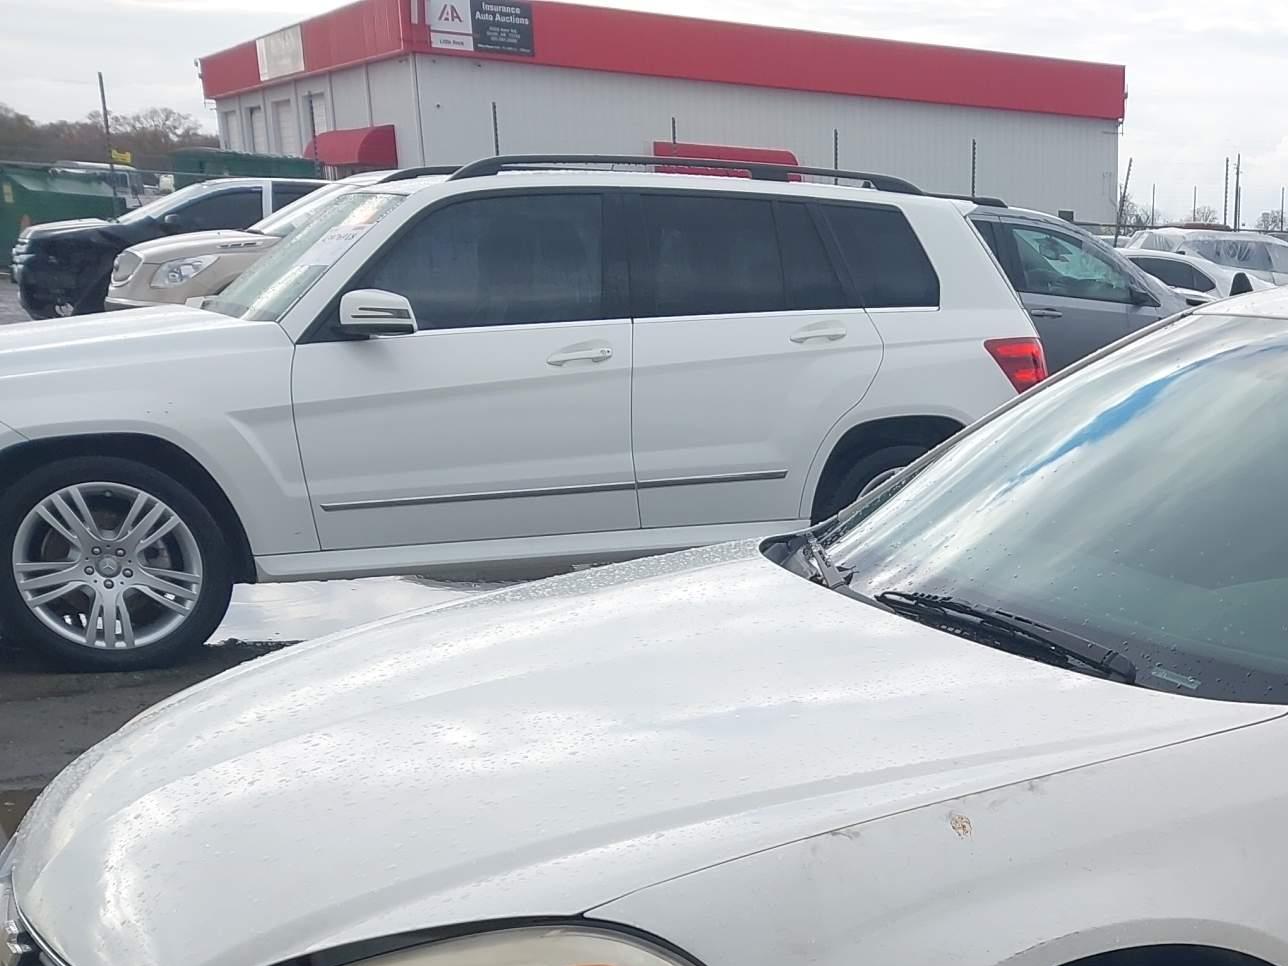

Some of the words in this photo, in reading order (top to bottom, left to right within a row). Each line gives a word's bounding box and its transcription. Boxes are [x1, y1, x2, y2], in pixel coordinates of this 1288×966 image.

[482, 2, 521, 14] Insurance
[475, 11, 494, 21] Auto
[495, 13, 529, 25] Auctions
